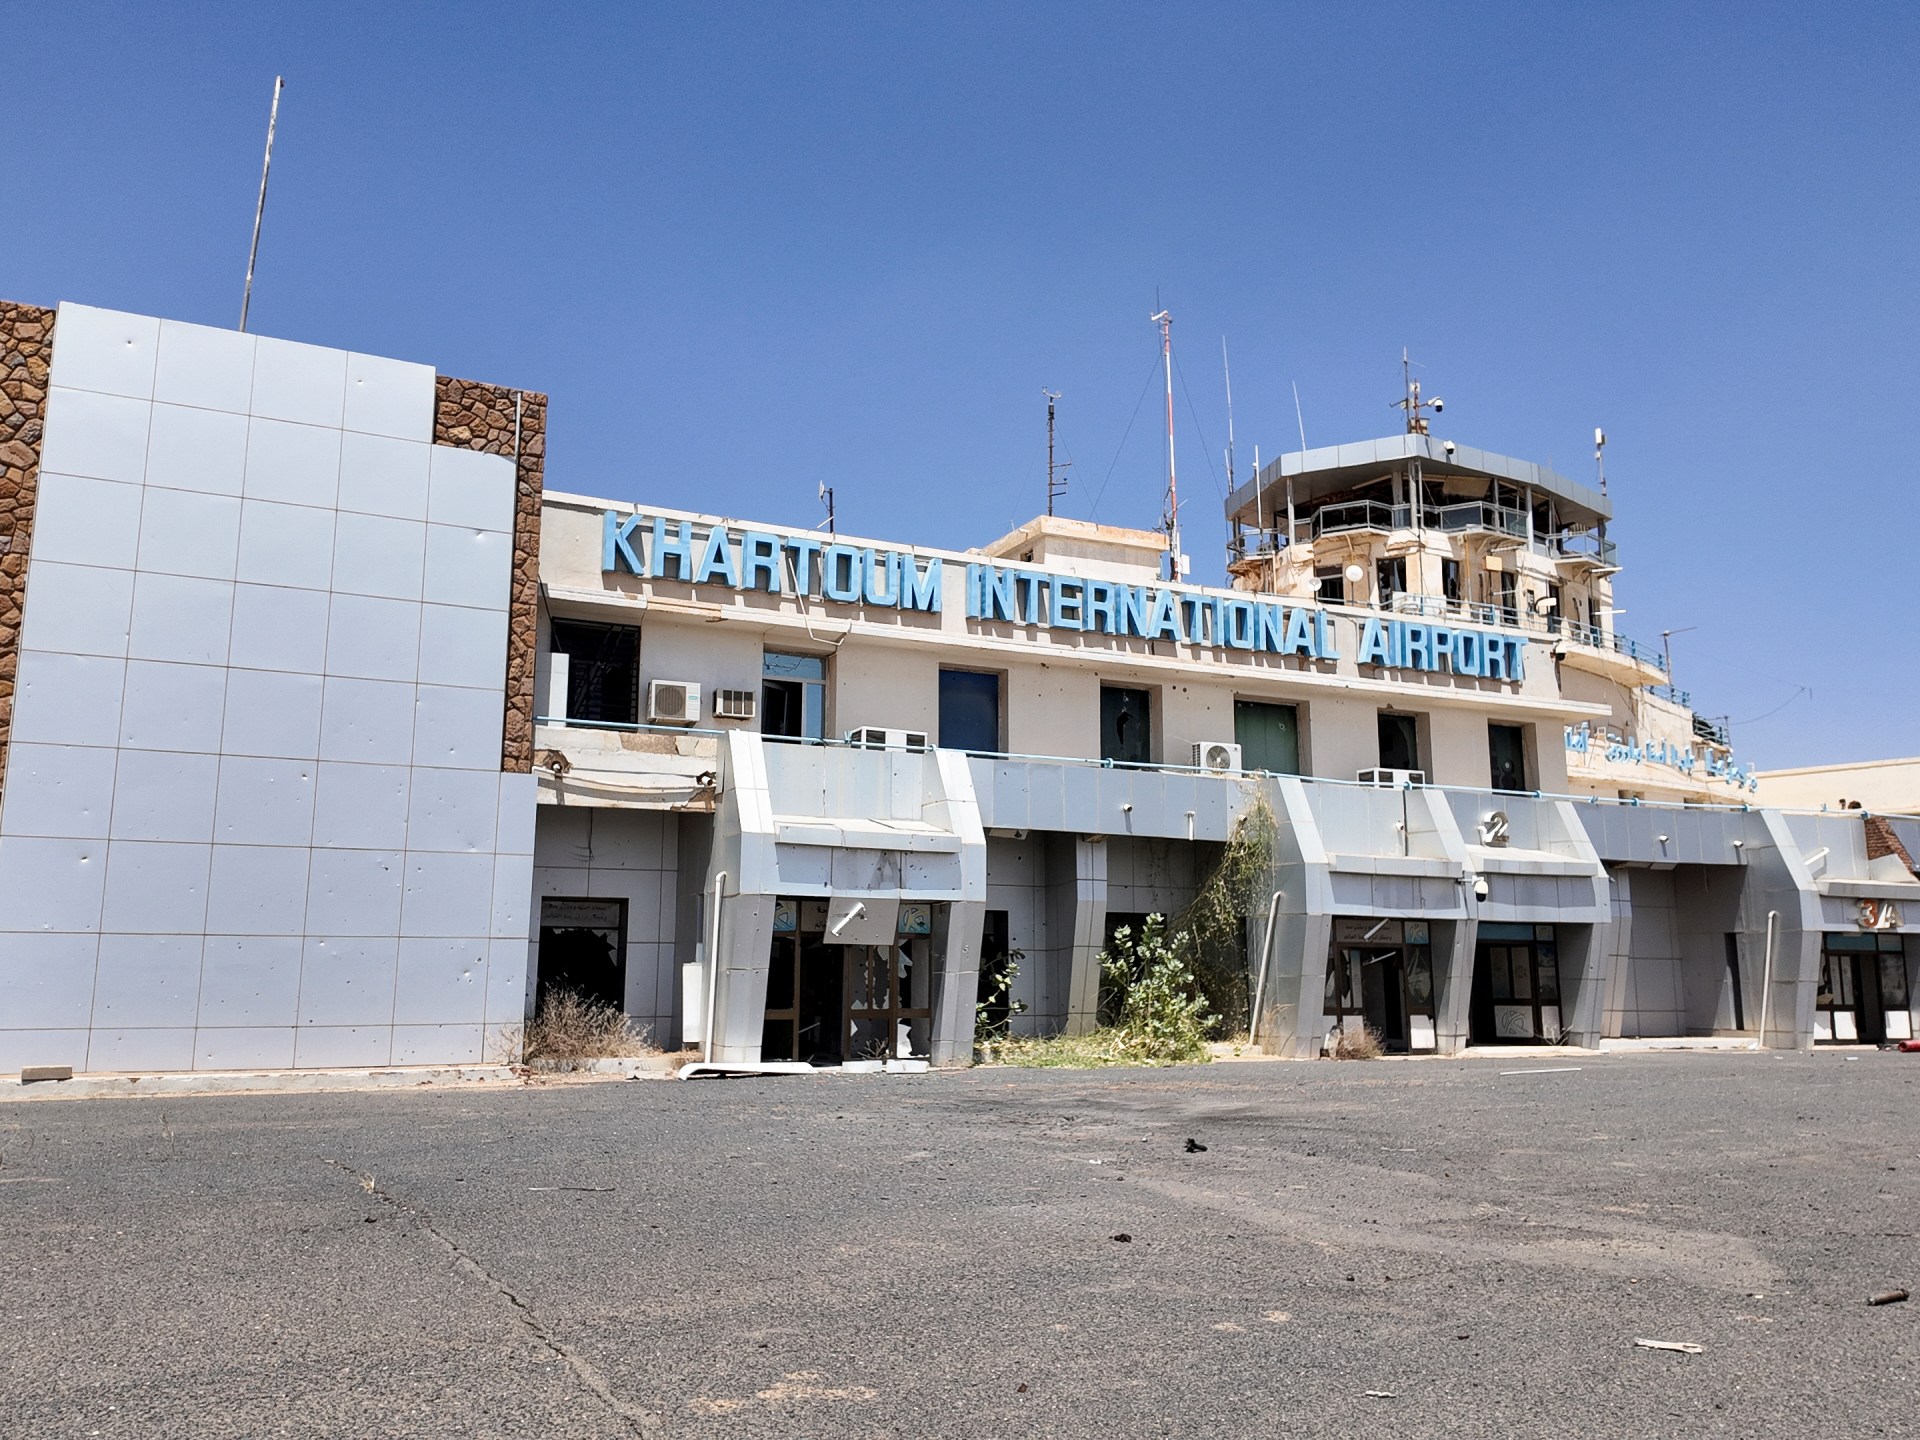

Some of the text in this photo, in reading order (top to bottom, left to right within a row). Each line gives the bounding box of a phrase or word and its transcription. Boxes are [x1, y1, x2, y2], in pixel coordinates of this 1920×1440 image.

[602, 510, 1529, 681] KHARTOUM INTERNATIONAL AIRPORT
[1477, 810, 1510, 847] 2
